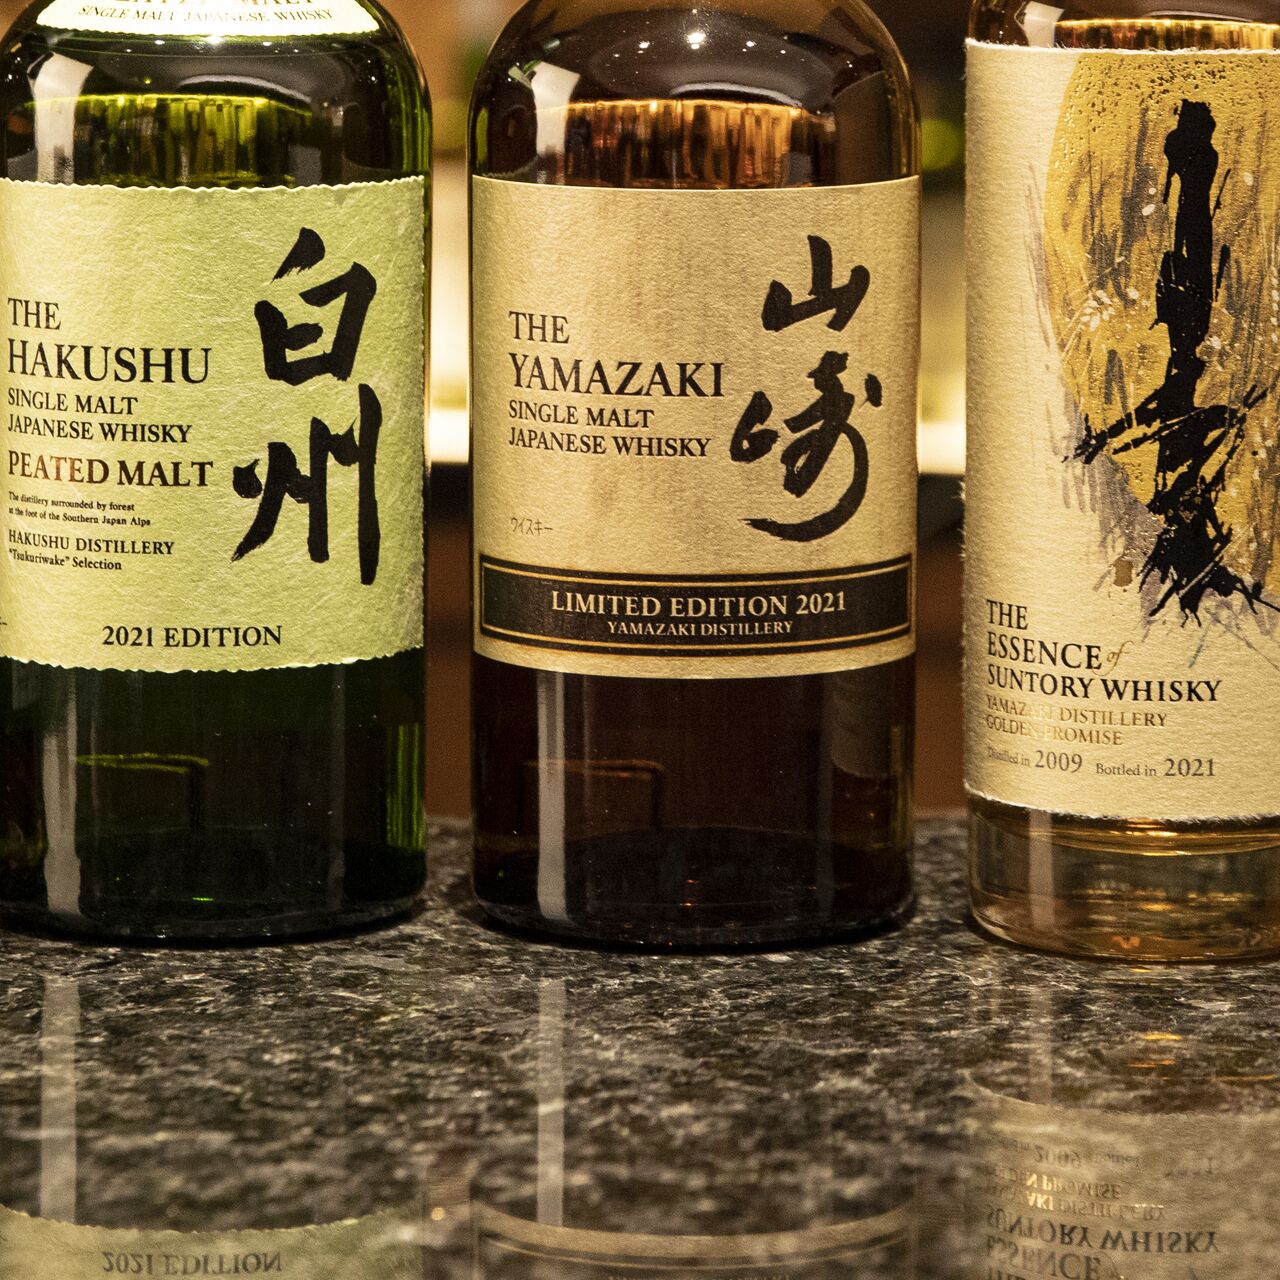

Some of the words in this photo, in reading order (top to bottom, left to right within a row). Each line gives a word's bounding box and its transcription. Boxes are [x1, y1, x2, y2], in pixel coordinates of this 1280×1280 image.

[79, 5, 129, 19] SINGLE
[8, 298, 61, 330] THE
[509, 311, 570, 344] THE
[8, 338, 211, 384] HAKUSHU
[509, 352, 724, 397] YAMAZAKI
[9, 387, 68, 411] SINGLE
[75, 395, 138, 415] MALT
[730, 235, 883, 542] 山崎
[230, 227, 382, 585] 白州
[509, 400, 578, 425] SINGLE
[586, 408, 655, 428] MALT
[9, 414, 93, 440] JAPANESE
[99, 423, 193, 443] WHISKY
[509, 427, 606, 455] JAPANESE
[612, 436, 711, 457] WHISKY
[8, 450, 110, 484] PEATED
[117, 460, 213, 487] MALT
[9, 491, 19, 502] The
[21, 494, 48, 506] distillery
[51, 500, 93, 509] surrounded
[97, 501, 106, 511] by
[110, 502, 134, 511] forest
[15, 507, 23, 515] the
[25, 509, 38, 518] foot
[40, 510, 46, 519] of
[49, 512, 60, 520] the
[63, 514, 98, 524] Southern
[102, 516, 126, 526] Japan
[130, 517, 150, 527] Alps
[510, 517, 553, 536] ウイスキー
[9, 529, 69, 550] HAKUSHU
[76, 538, 175, 555] DISTILLERY
[72, 556, 122, 570] Selection
[551, 590, 661, 617] LIMITED
[670, 595, 787, 618] EDITION
[796, 591, 845, 616] 2021
[986, 599, 1028, 630] THE
[102, 625, 153, 647] 2021
[164, 625, 282, 649] EDITION
[607, 621, 697, 636] YAMAZAKI
[699, 620, 794, 636] DISTILLERY
[988, 631, 1102, 670] ESSENCE
[1092, 641, 1134, 676] of
[987, 664, 1094, 699] SUNTORY
[1101, 679, 1222, 702] WHISKY
[1060, 706, 1167, 727] DISTILLERY
[1021, 753, 1030, 766] in
[1035, 750, 1083, 773] 2009
[1096, 762, 1140, 776] Bottled
[1145, 764, 1157, 777] in
[1163, 758, 1216, 777] 2021
